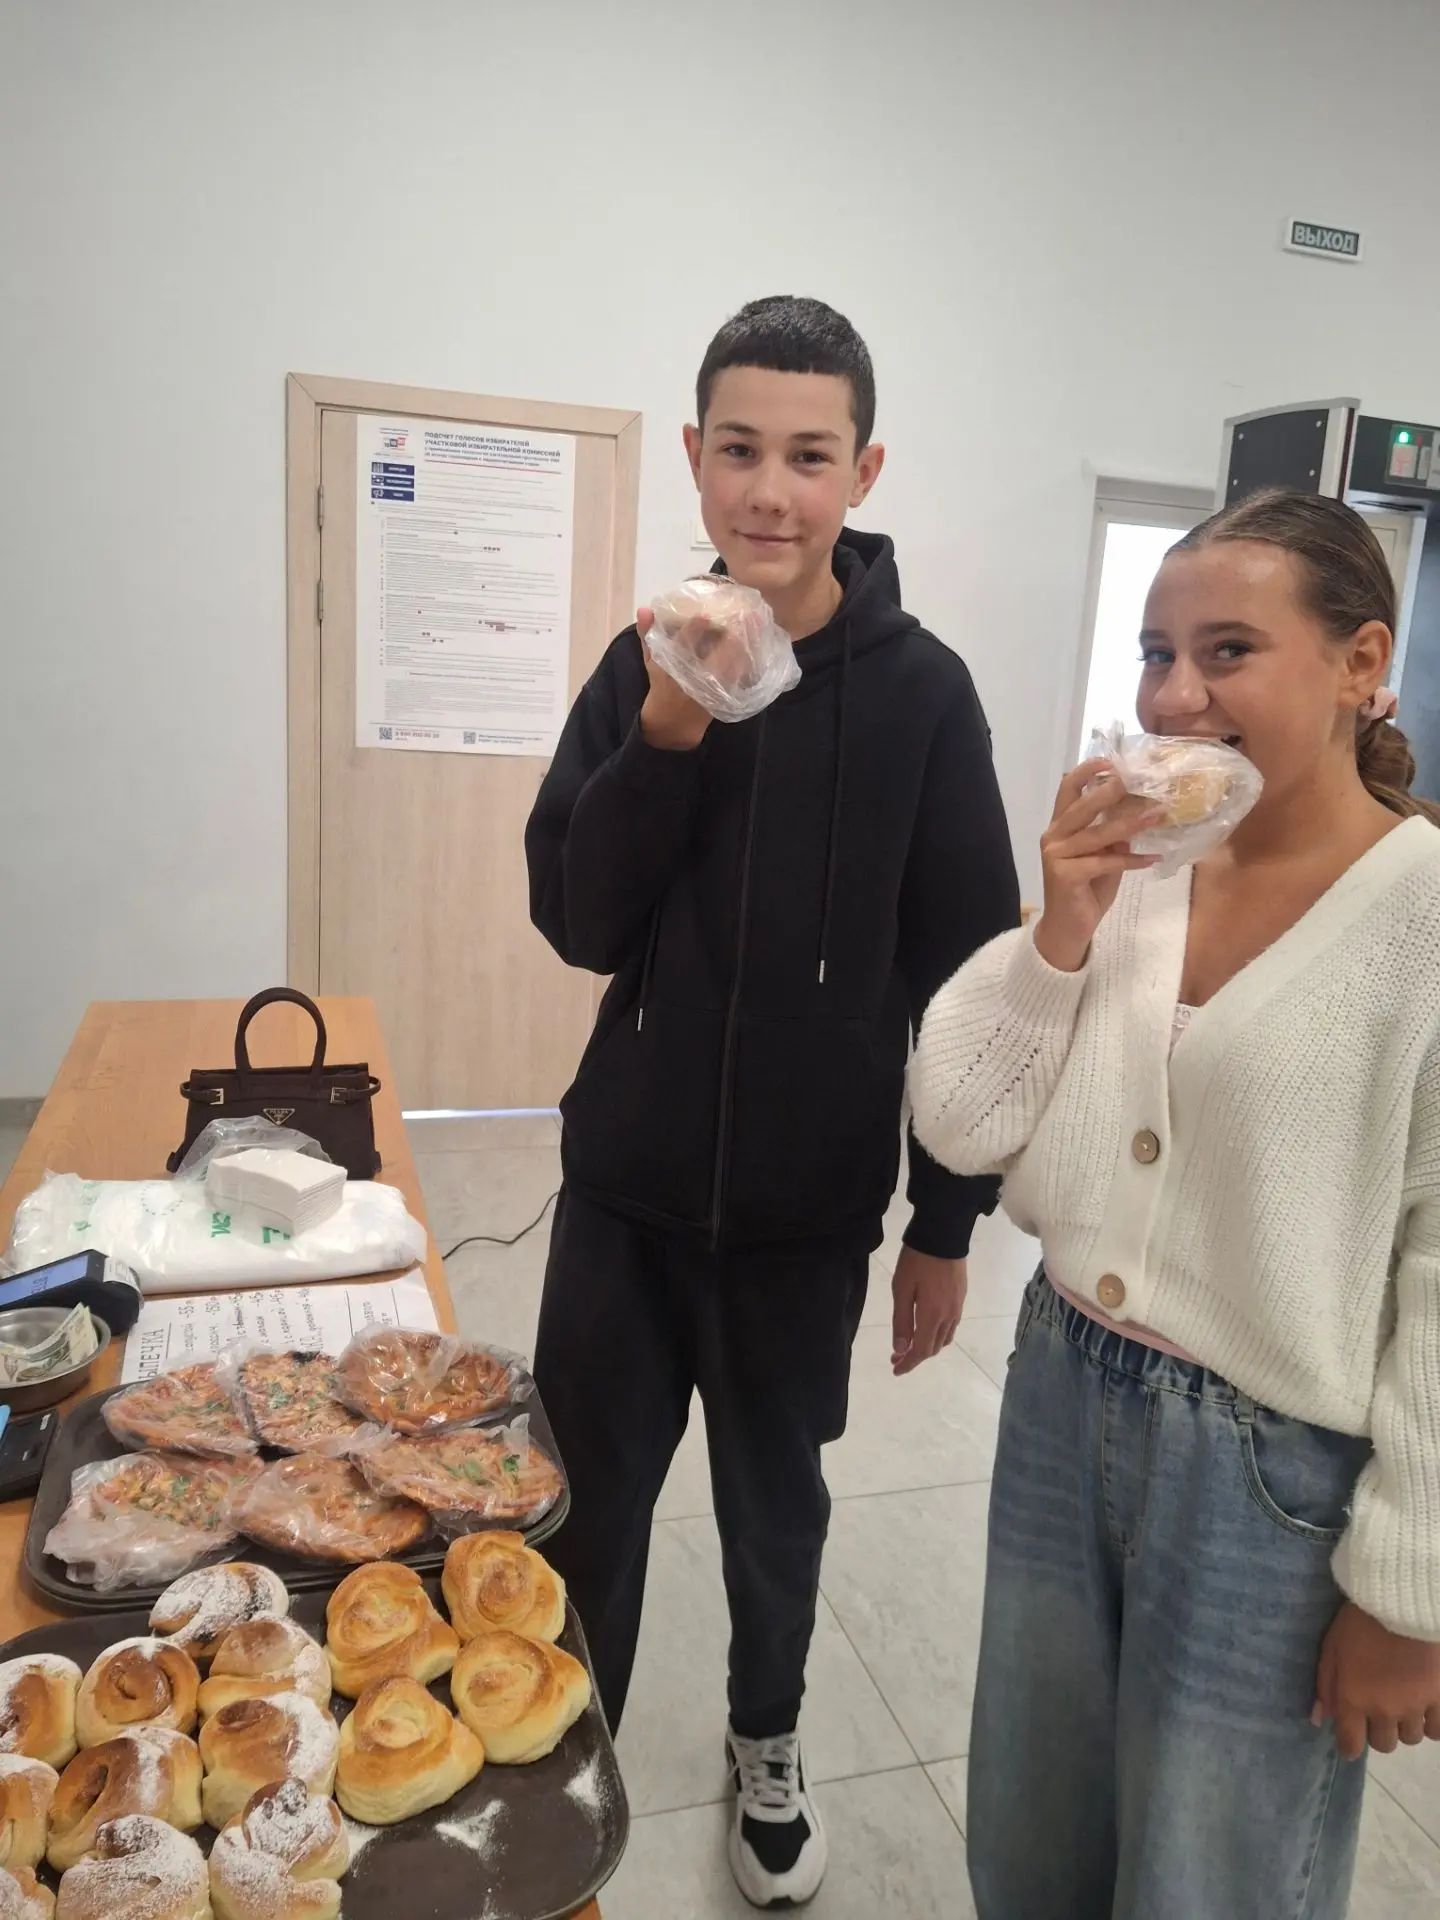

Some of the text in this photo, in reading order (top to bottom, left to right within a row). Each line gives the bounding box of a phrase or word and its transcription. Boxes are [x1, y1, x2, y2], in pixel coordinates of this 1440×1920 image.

[1294, 225, 1356, 254] ВЫХОД
[424, 439, 467, 449] УЧАСТКОВОЙ
[468, 443, 521, 453] ИЗБИРАТЕЛЬНОЙ
[522, 449, 561, 457] КОМИССИЕЙ
[455, 434, 485, 443] ГОЛОСОВ
[486, 437, 530, 447] ИЗБИРАТЕЛЕЙ
[138, 1328, 165, 1379] ЫПЕЧКА
